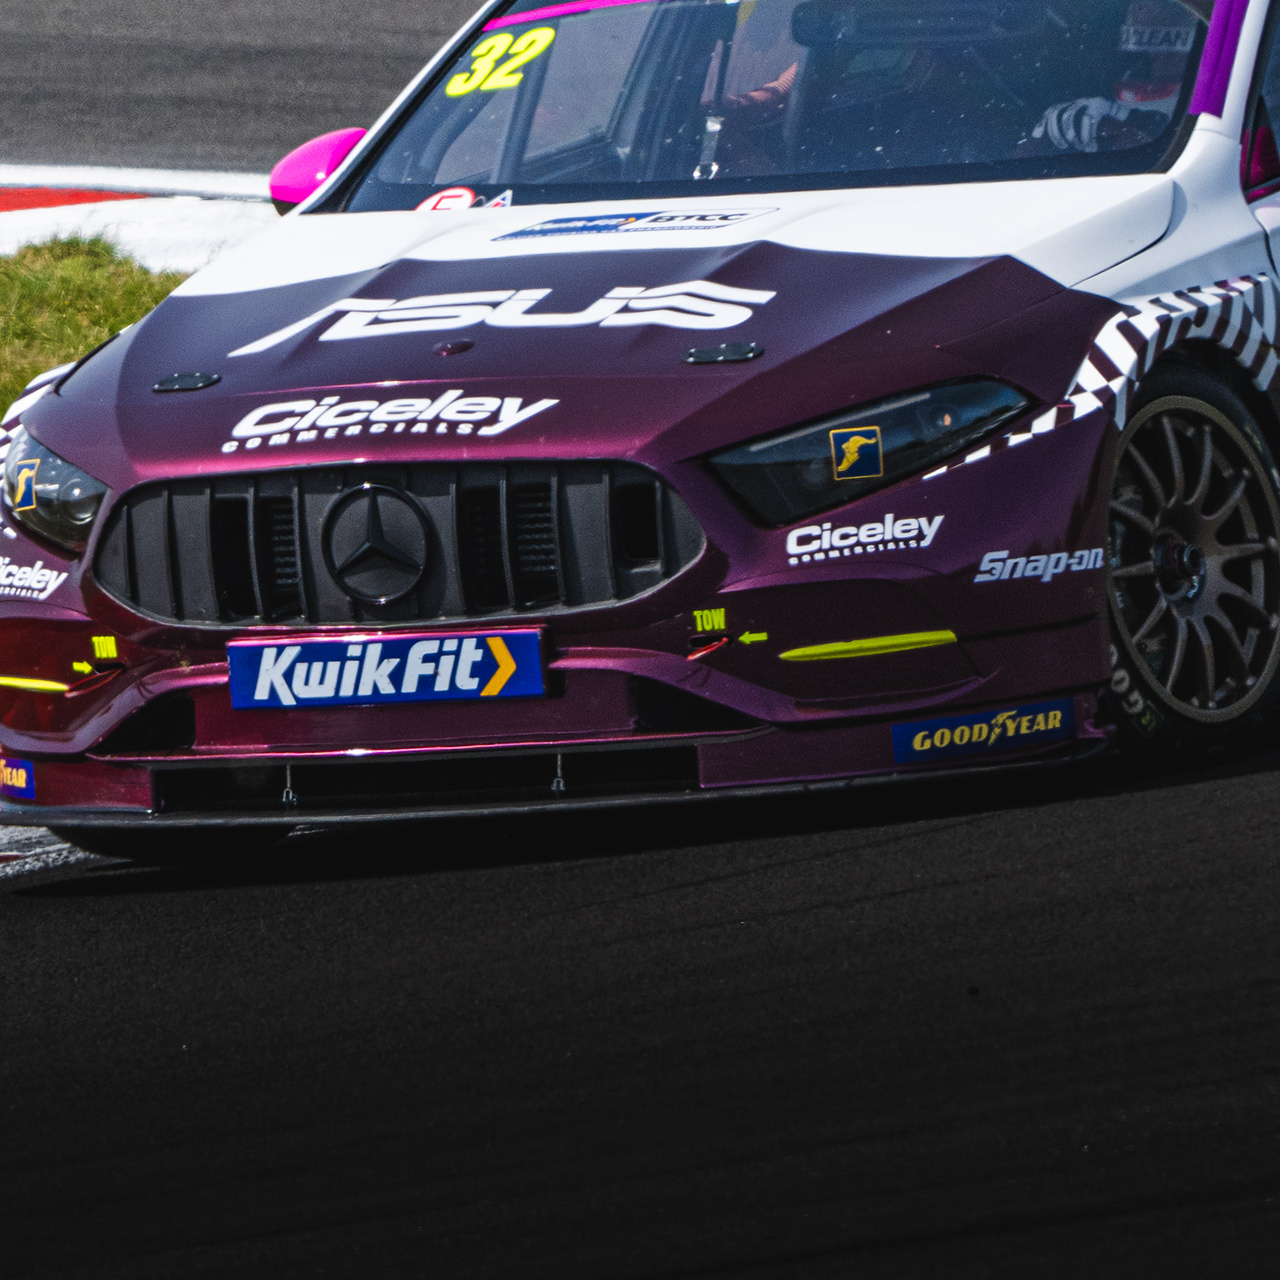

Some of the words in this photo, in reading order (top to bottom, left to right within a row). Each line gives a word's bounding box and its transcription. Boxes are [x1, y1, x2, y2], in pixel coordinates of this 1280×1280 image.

[445, 27, 556, 97] 32
[646, 212, 749, 223] BTCC
[227, 280, 777, 358] ASUS
[232, 389, 560, 438] Ciceley
[221, 422, 474, 453] COMMERCIALS
[786, 513, 945, 555] Ciceley
[788, 539, 918, 566] COMMERCIALS
[973, 548, 1104, 583] Snap-on
[693, 608, 726, 632] TOW
[91, 635, 118, 659] TOW
